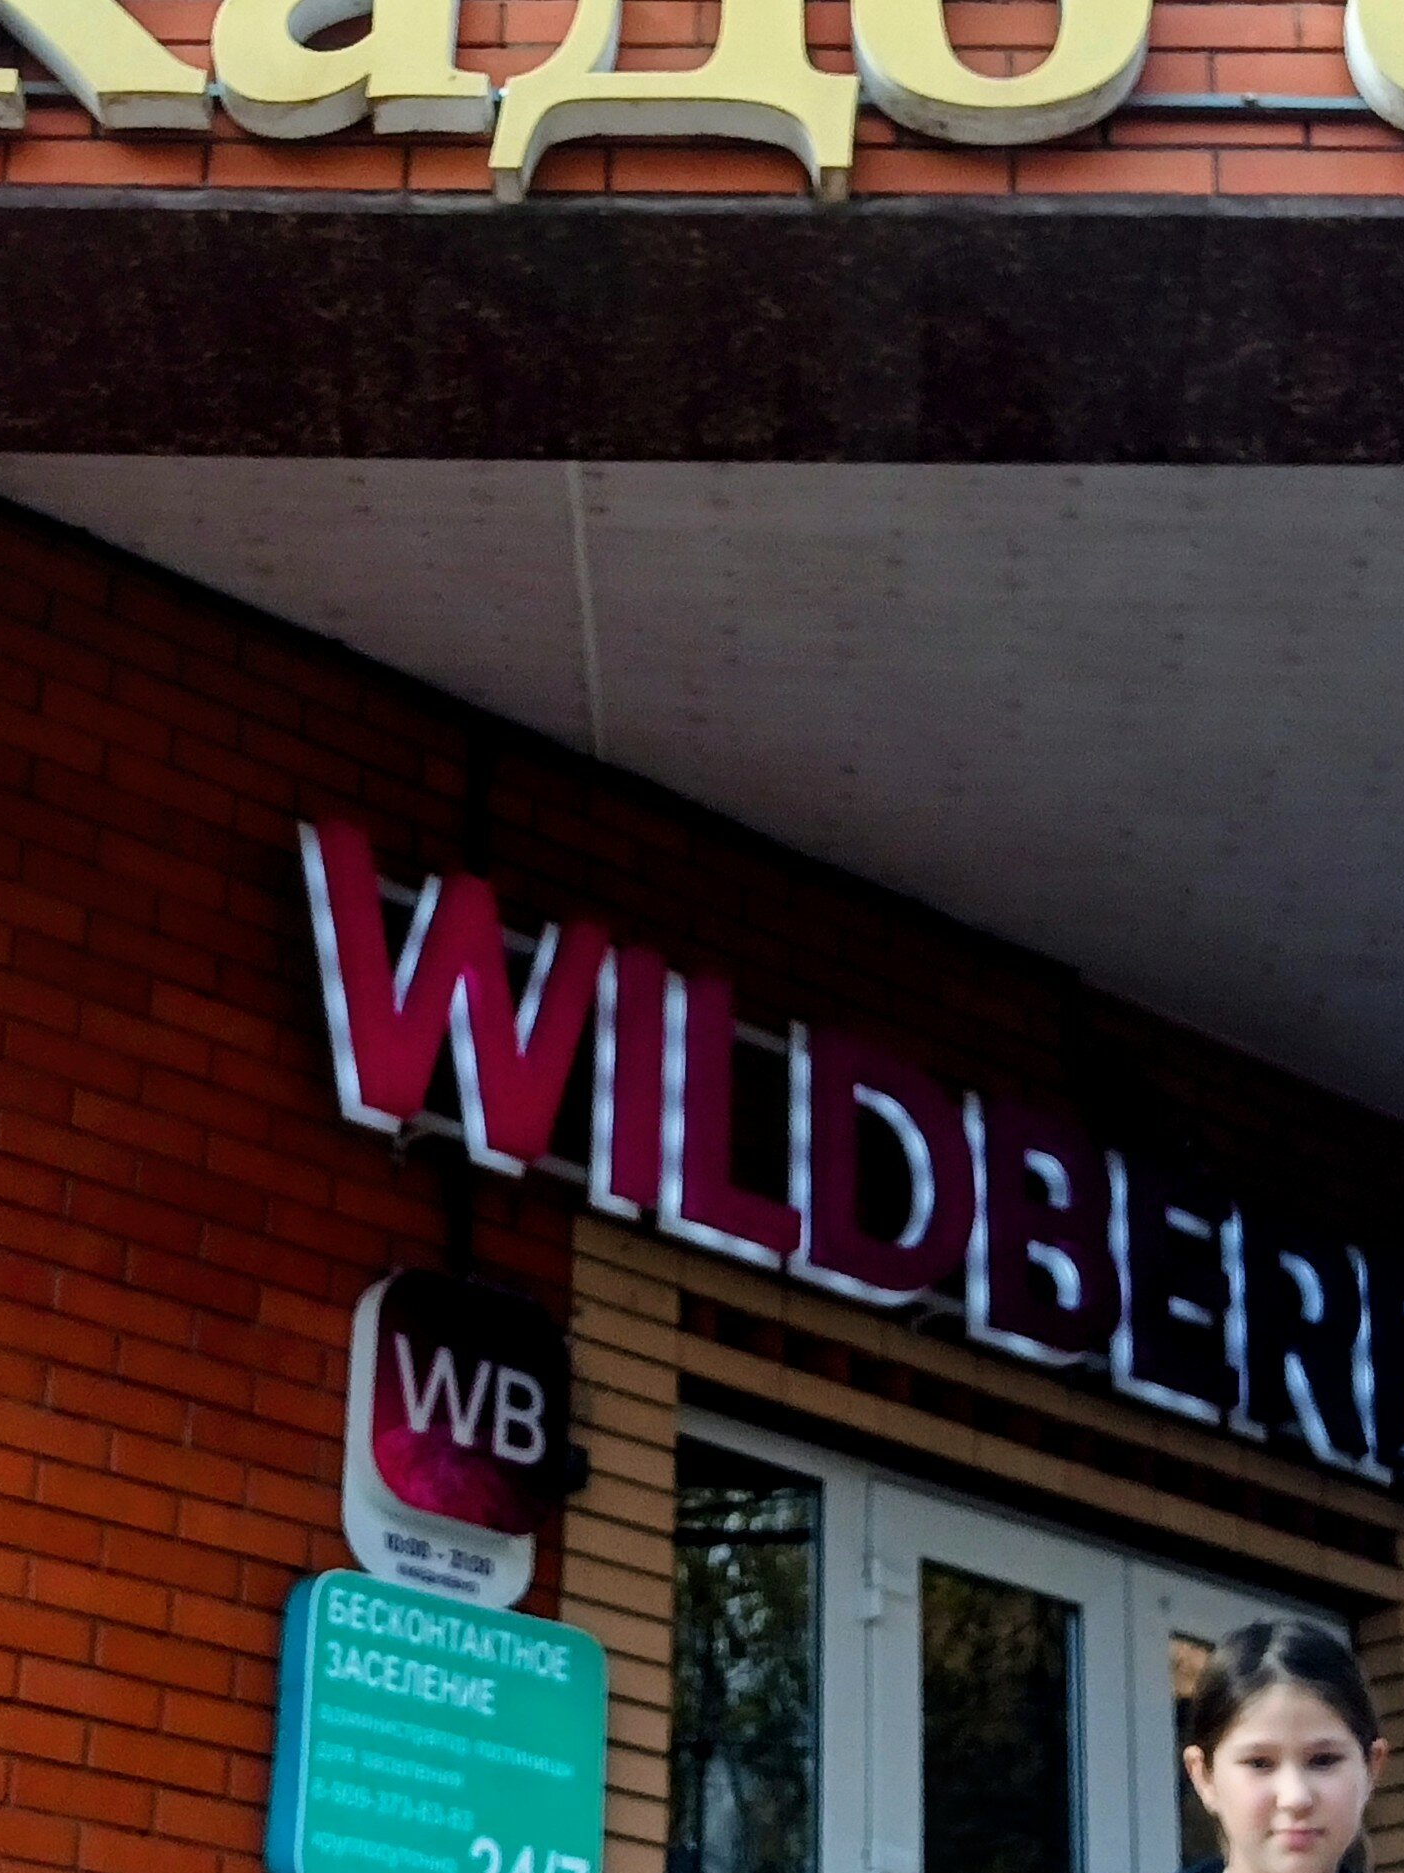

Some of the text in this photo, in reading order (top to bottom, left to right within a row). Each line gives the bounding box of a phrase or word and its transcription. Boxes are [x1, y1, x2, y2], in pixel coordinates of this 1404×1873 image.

[394, 1332, 547, 1466] WB
[325, 1640, 496, 1718] ЗАСЕЛЕНИЕ
[327, 1586, 571, 1682] БЕСКОНТАКТНОЕ
